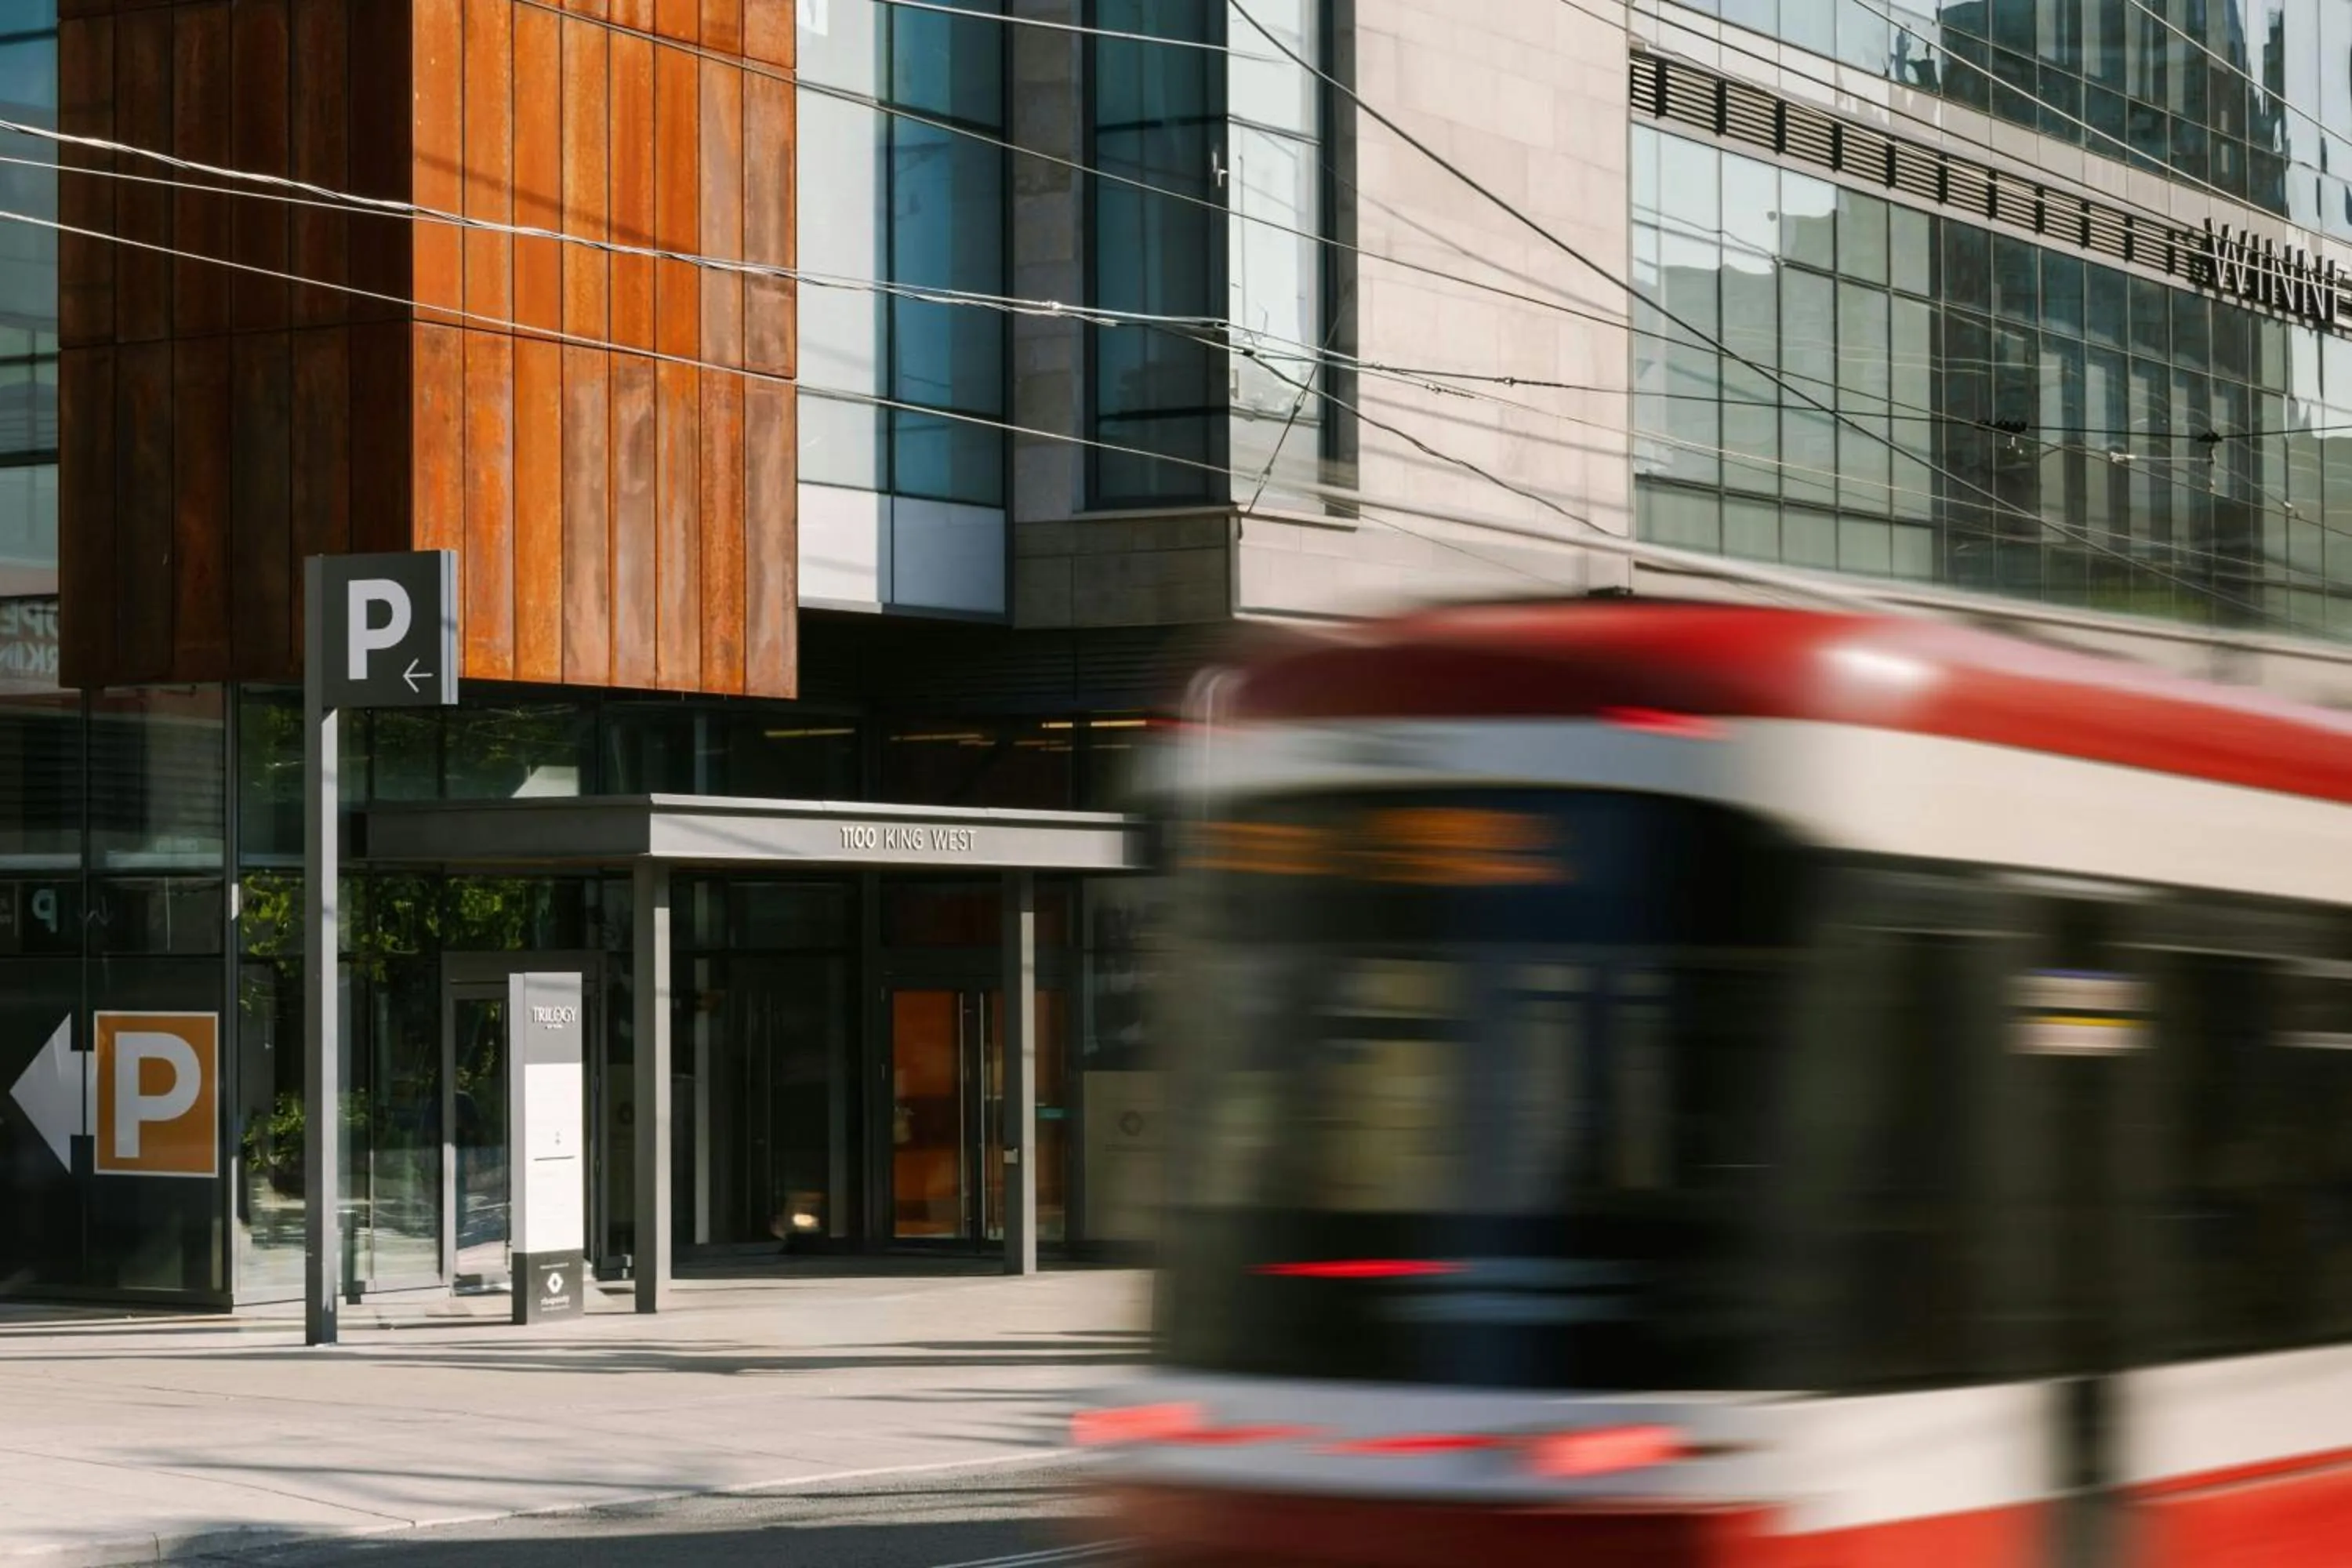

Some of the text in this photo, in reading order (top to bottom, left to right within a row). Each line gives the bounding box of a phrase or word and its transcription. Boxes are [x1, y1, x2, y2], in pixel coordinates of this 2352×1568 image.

[348, 579, 411, 680] P
[840, 826, 977, 851] 1100 KING WEST
[532, 1006, 577, 1023] TRILOGY
[115, 1032, 201, 1158] P
